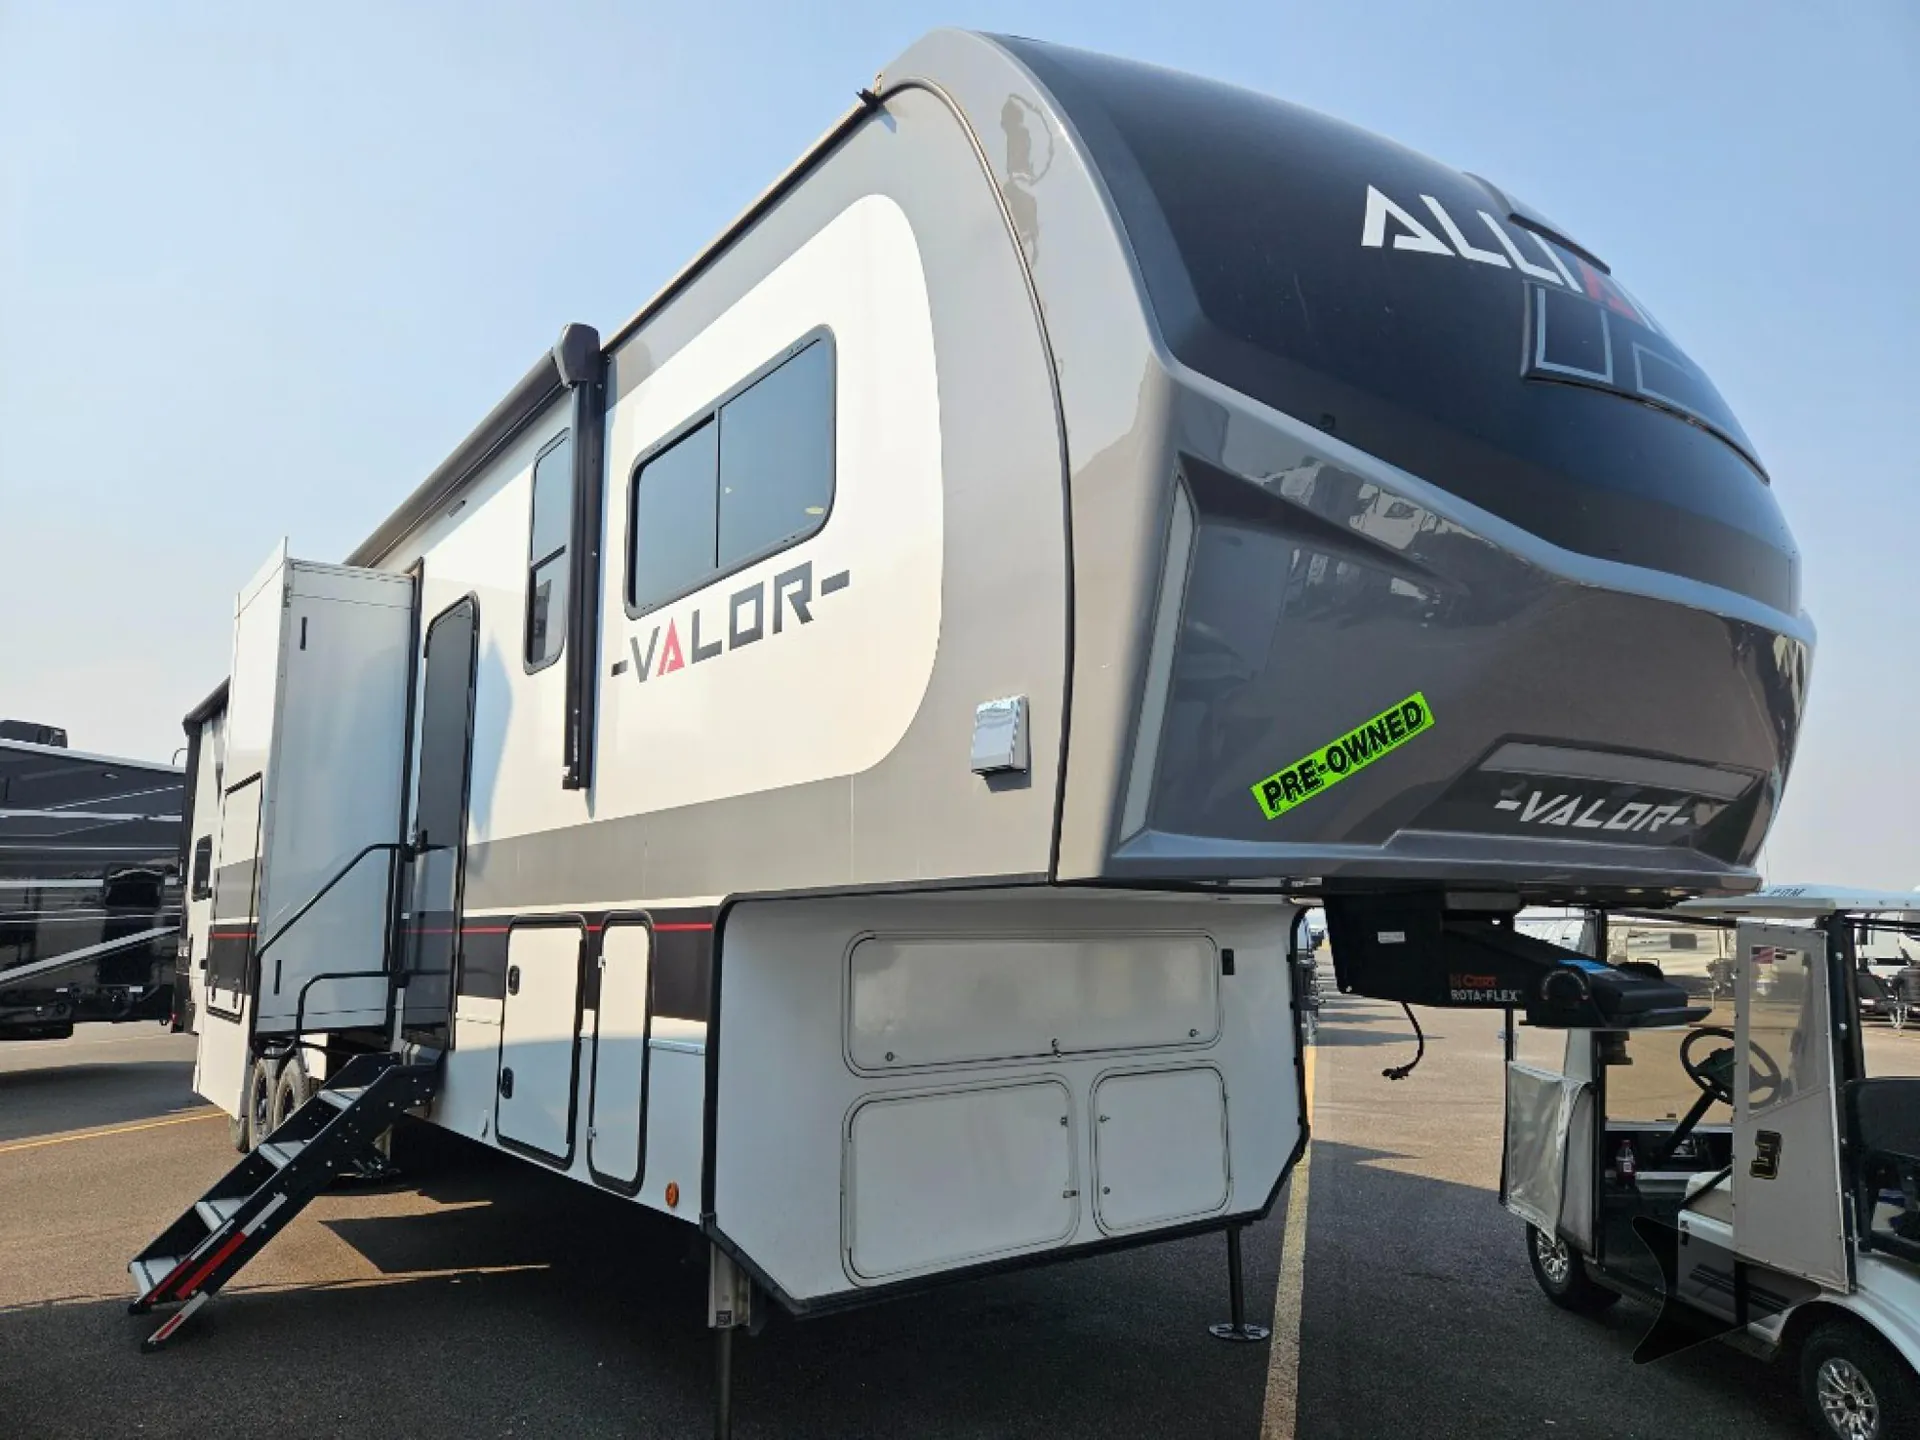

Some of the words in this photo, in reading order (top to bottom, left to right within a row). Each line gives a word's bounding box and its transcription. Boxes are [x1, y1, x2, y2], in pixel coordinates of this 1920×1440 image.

[1262, 700, 1425, 813] PRE-OWNED
[1450, 989, 1519, 1002] ROTA-FLEX
[1749, 1129, 1782, 1180] 3
